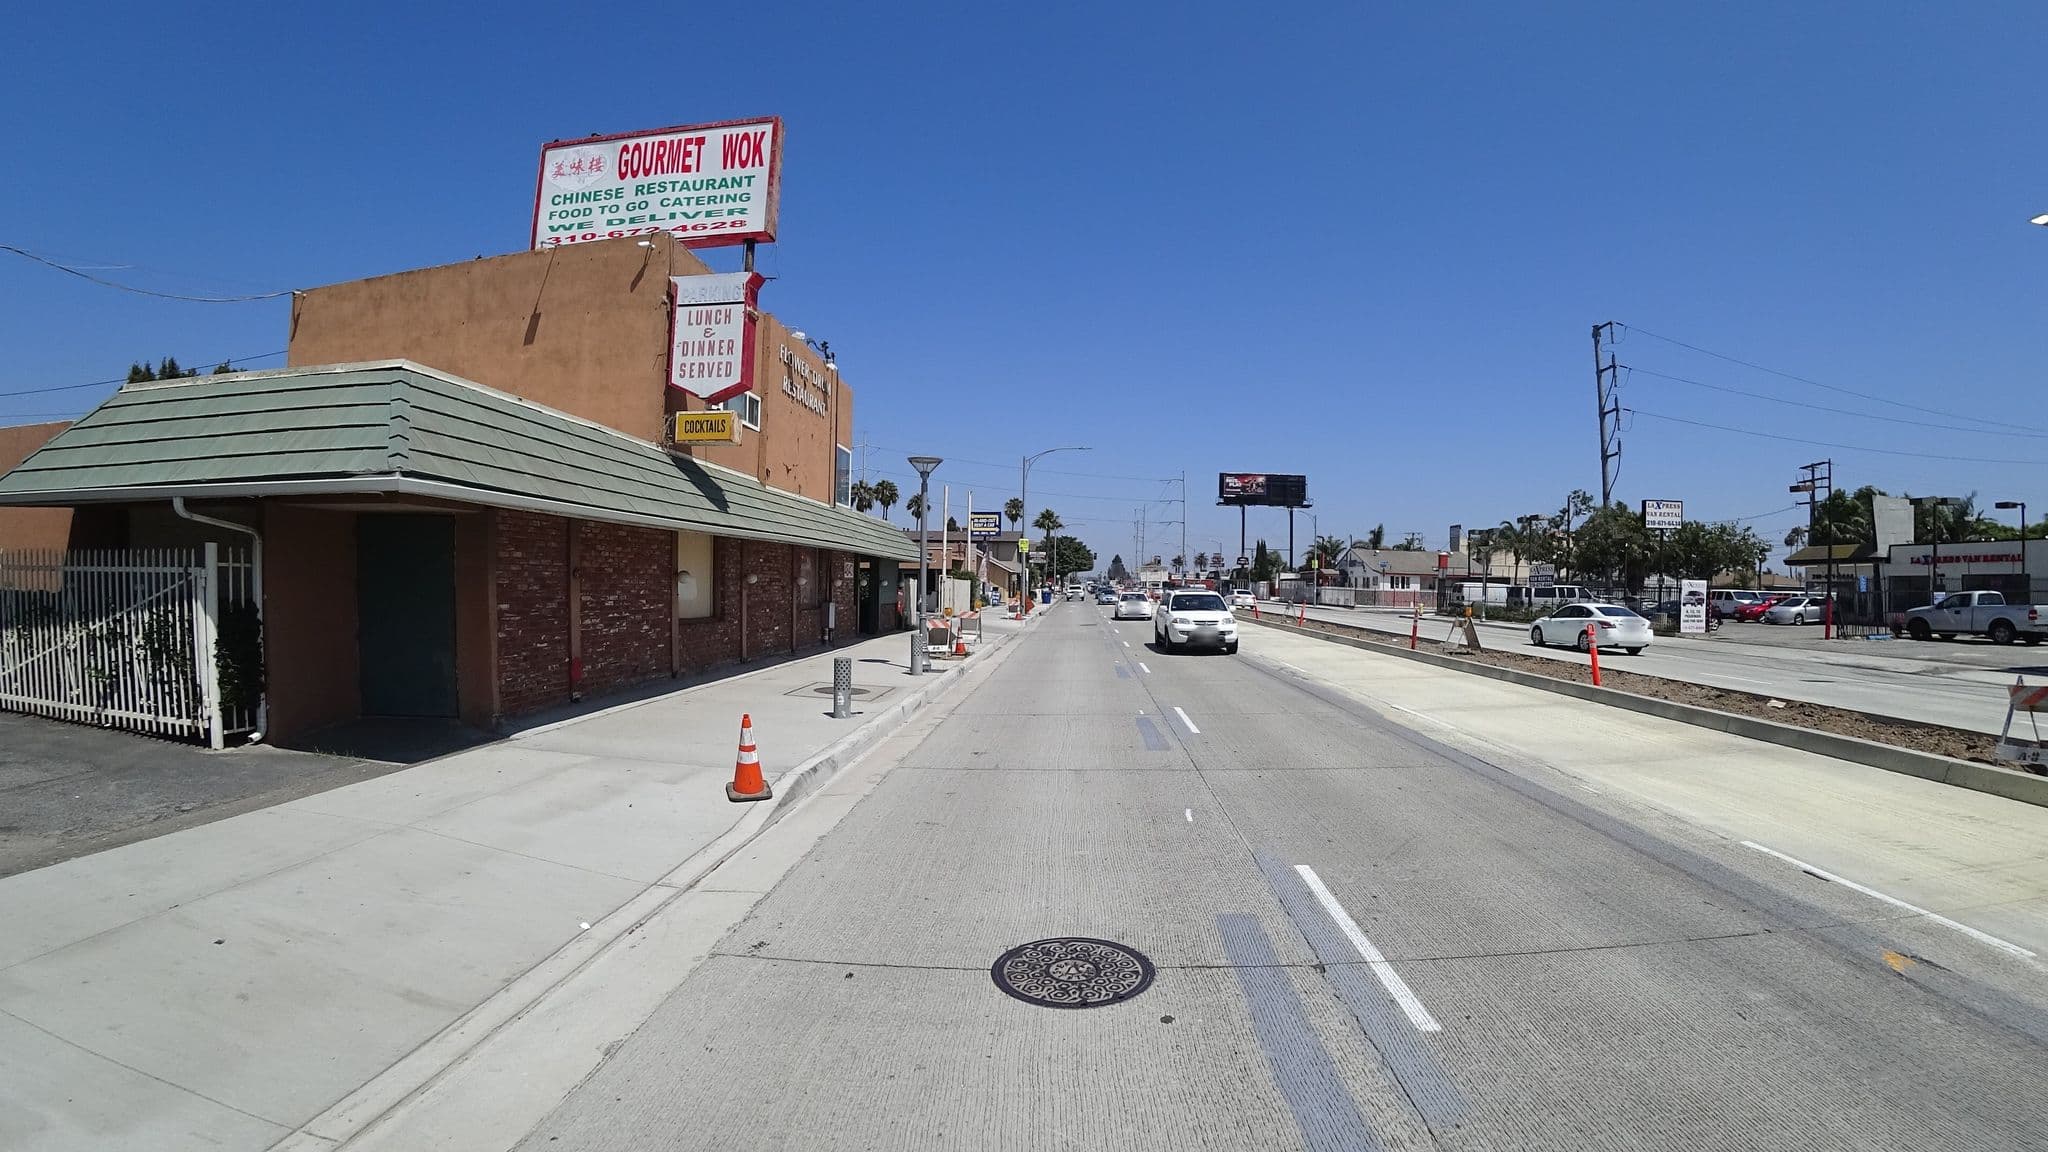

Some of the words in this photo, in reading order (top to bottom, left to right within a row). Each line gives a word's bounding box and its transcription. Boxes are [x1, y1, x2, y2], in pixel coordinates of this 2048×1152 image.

[618, 136, 706, 180] GOURMET
[722, 131, 766, 169] WOK
[551, 187, 625, 206] CHINESE
[634, 175, 756, 196] RESTAURANT
[549, 207, 593, 220] FOOD
[599, 204, 620, 214] TO
[625, 201, 649, 212] GO
[660, 193, 751, 208] CATERING
[548, 221, 594, 232] WE
[606, 207, 749, 227] DELIVER
[687, 308, 732, 326] LUNCH
[703, 327, 716, 338] &
[681, 338, 735, 357] DINNER
[679, 361, 732, 379] SERVED
[780, 343, 810, 379] FLOWER
[783, 375, 826, 417] RESTAURANT
[684, 418, 726, 434] COCKTAILS
[1983, 553, 2022, 562] RENTAL
